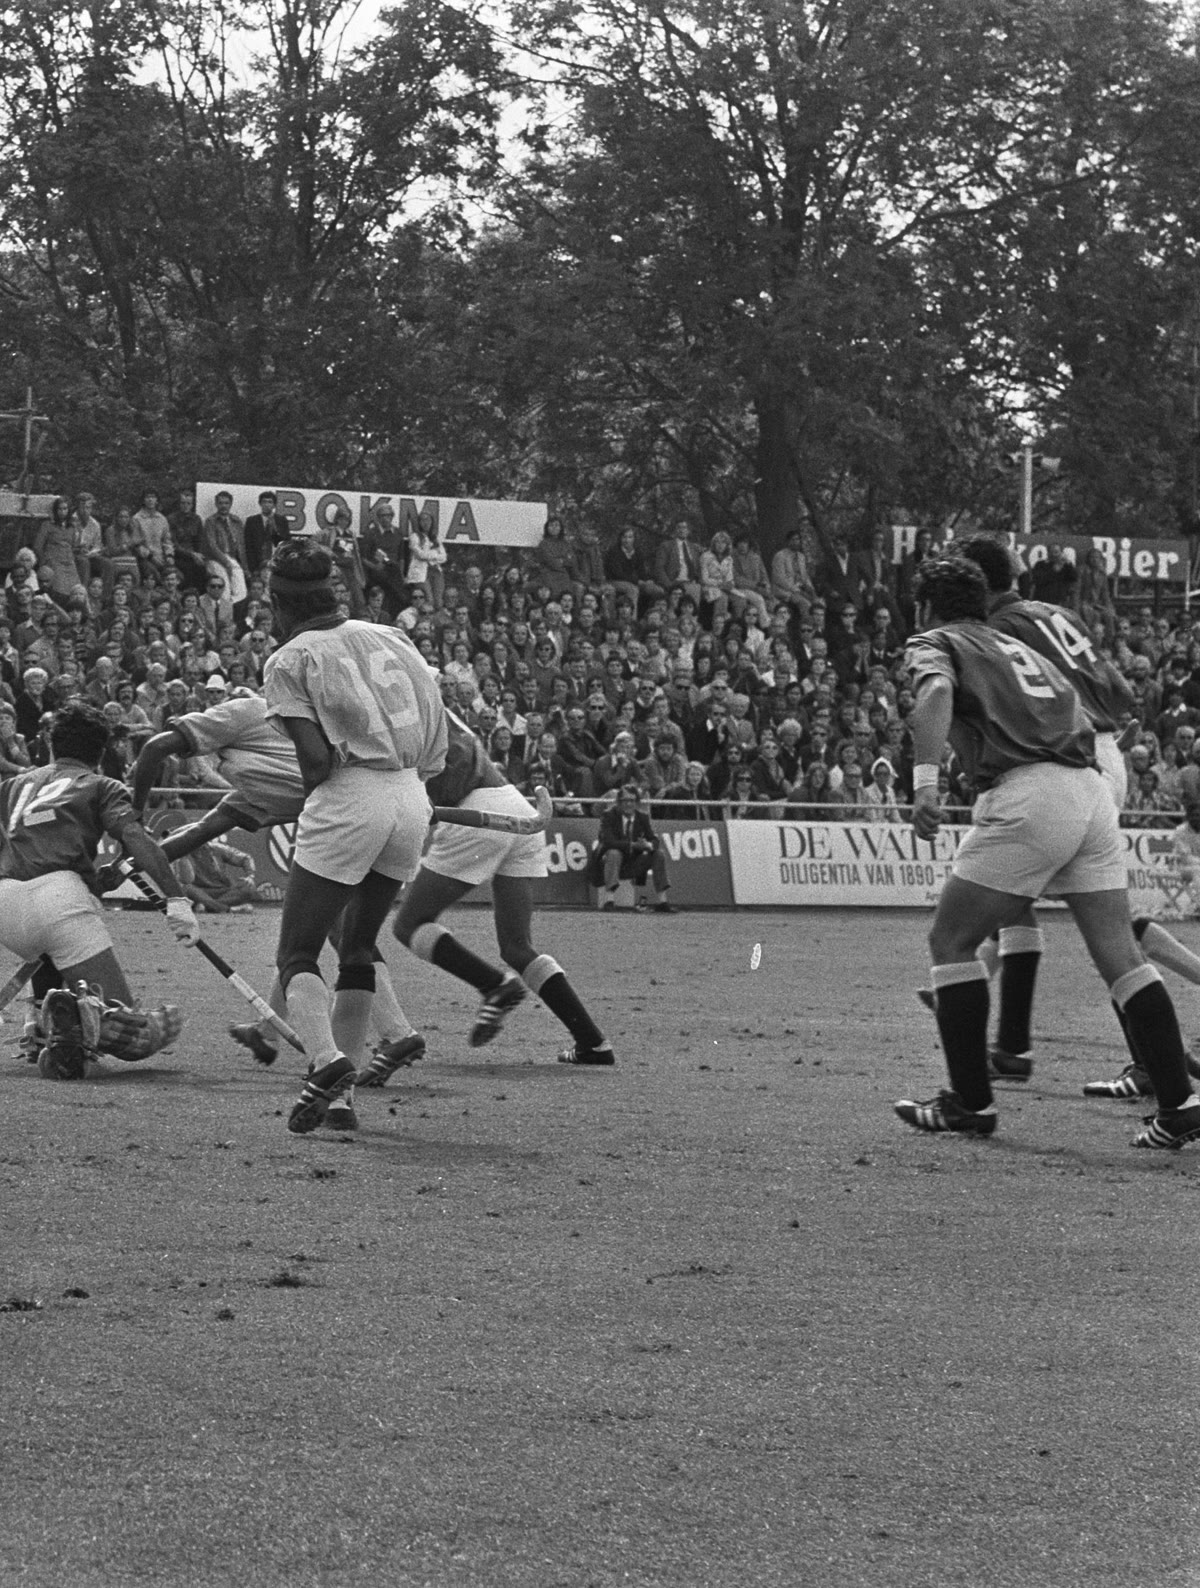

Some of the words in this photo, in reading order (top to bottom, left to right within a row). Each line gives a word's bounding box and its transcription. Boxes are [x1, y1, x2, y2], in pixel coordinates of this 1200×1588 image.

[276, 490, 480, 541] BOKMA
[1094, 535, 1179, 579] Bier
[1034, 612, 1098, 670] 14
[995, 640, 1057, 699] 2
[8, 778, 72, 832] 12
[662, 828, 721, 861] van
[779, 826, 833, 860] DE
[779, 863, 861, 885] DILIGENTIA
[865, 864, 894, 885] VAN
